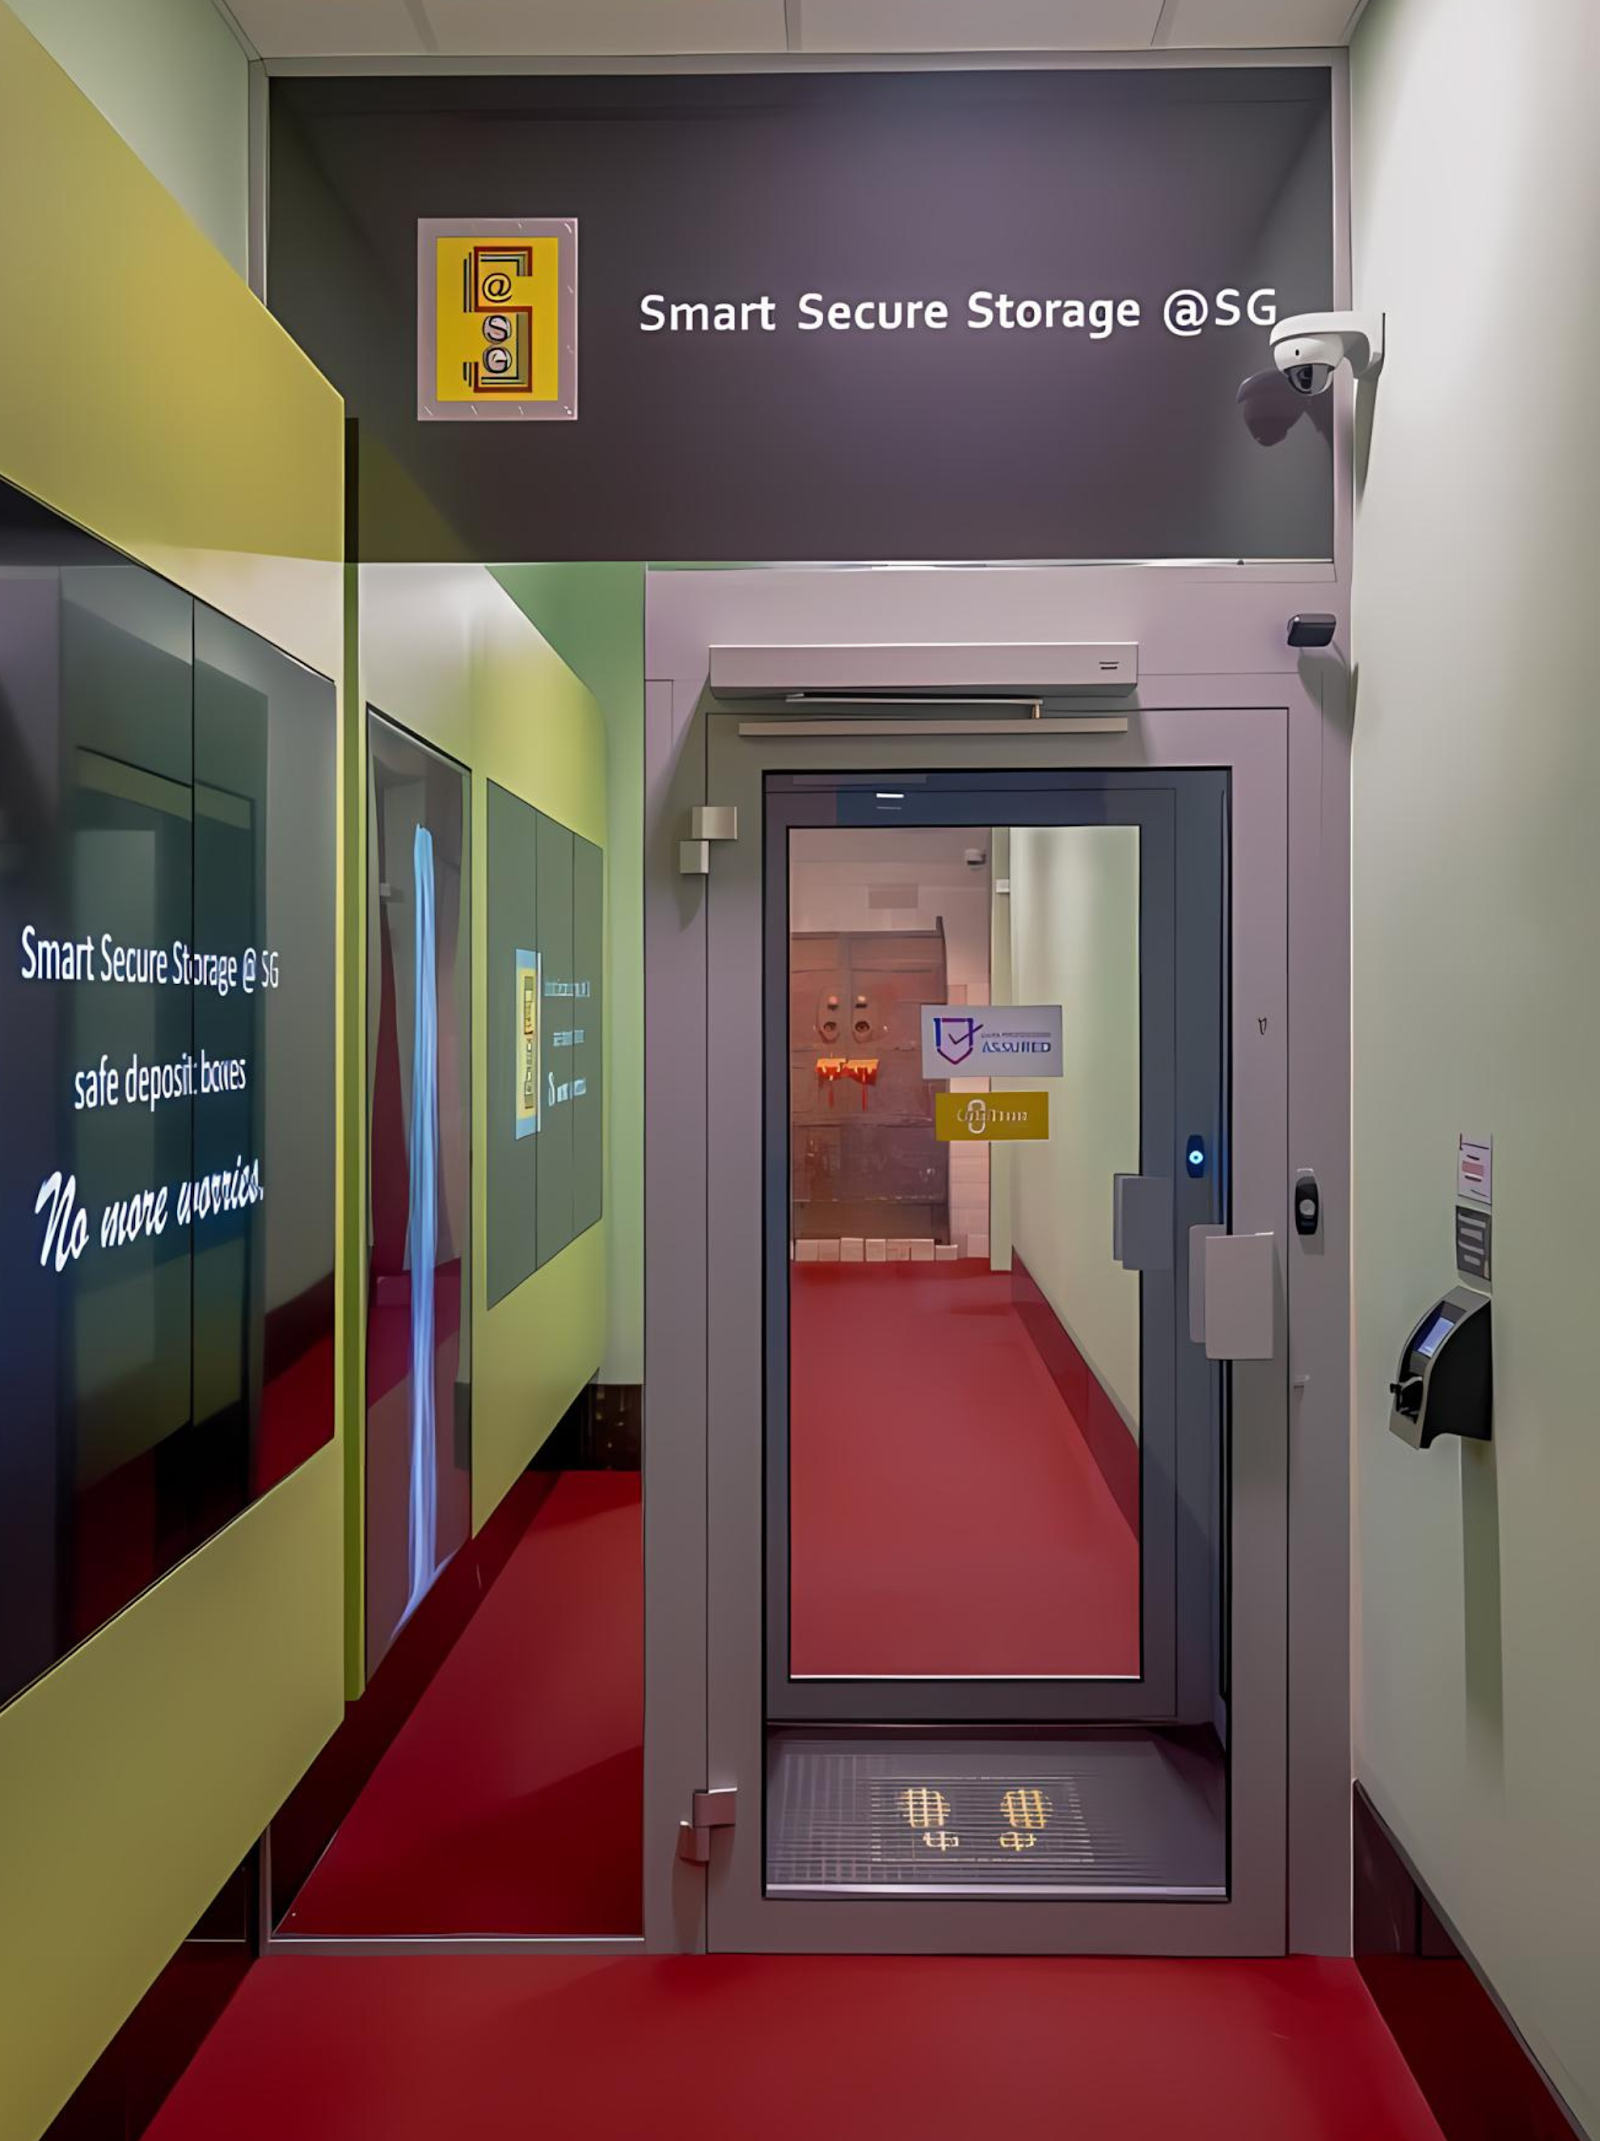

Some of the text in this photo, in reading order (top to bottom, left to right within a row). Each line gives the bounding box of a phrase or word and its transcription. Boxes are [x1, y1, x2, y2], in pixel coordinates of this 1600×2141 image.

[639, 287, 1278, 340] Smart Secure Storage @SG
[21, 925, 95, 981] Smart
[100, 934, 168, 984] Secure
[172, 940, 237, 997] Storage
[261, 950, 279, 989] SG
[74, 1054, 119, 1110] safe
[124, 1053, 198, 1112] deposit
[34, 1170, 89, 1273] No
[100, 1185, 169, 1249] more
